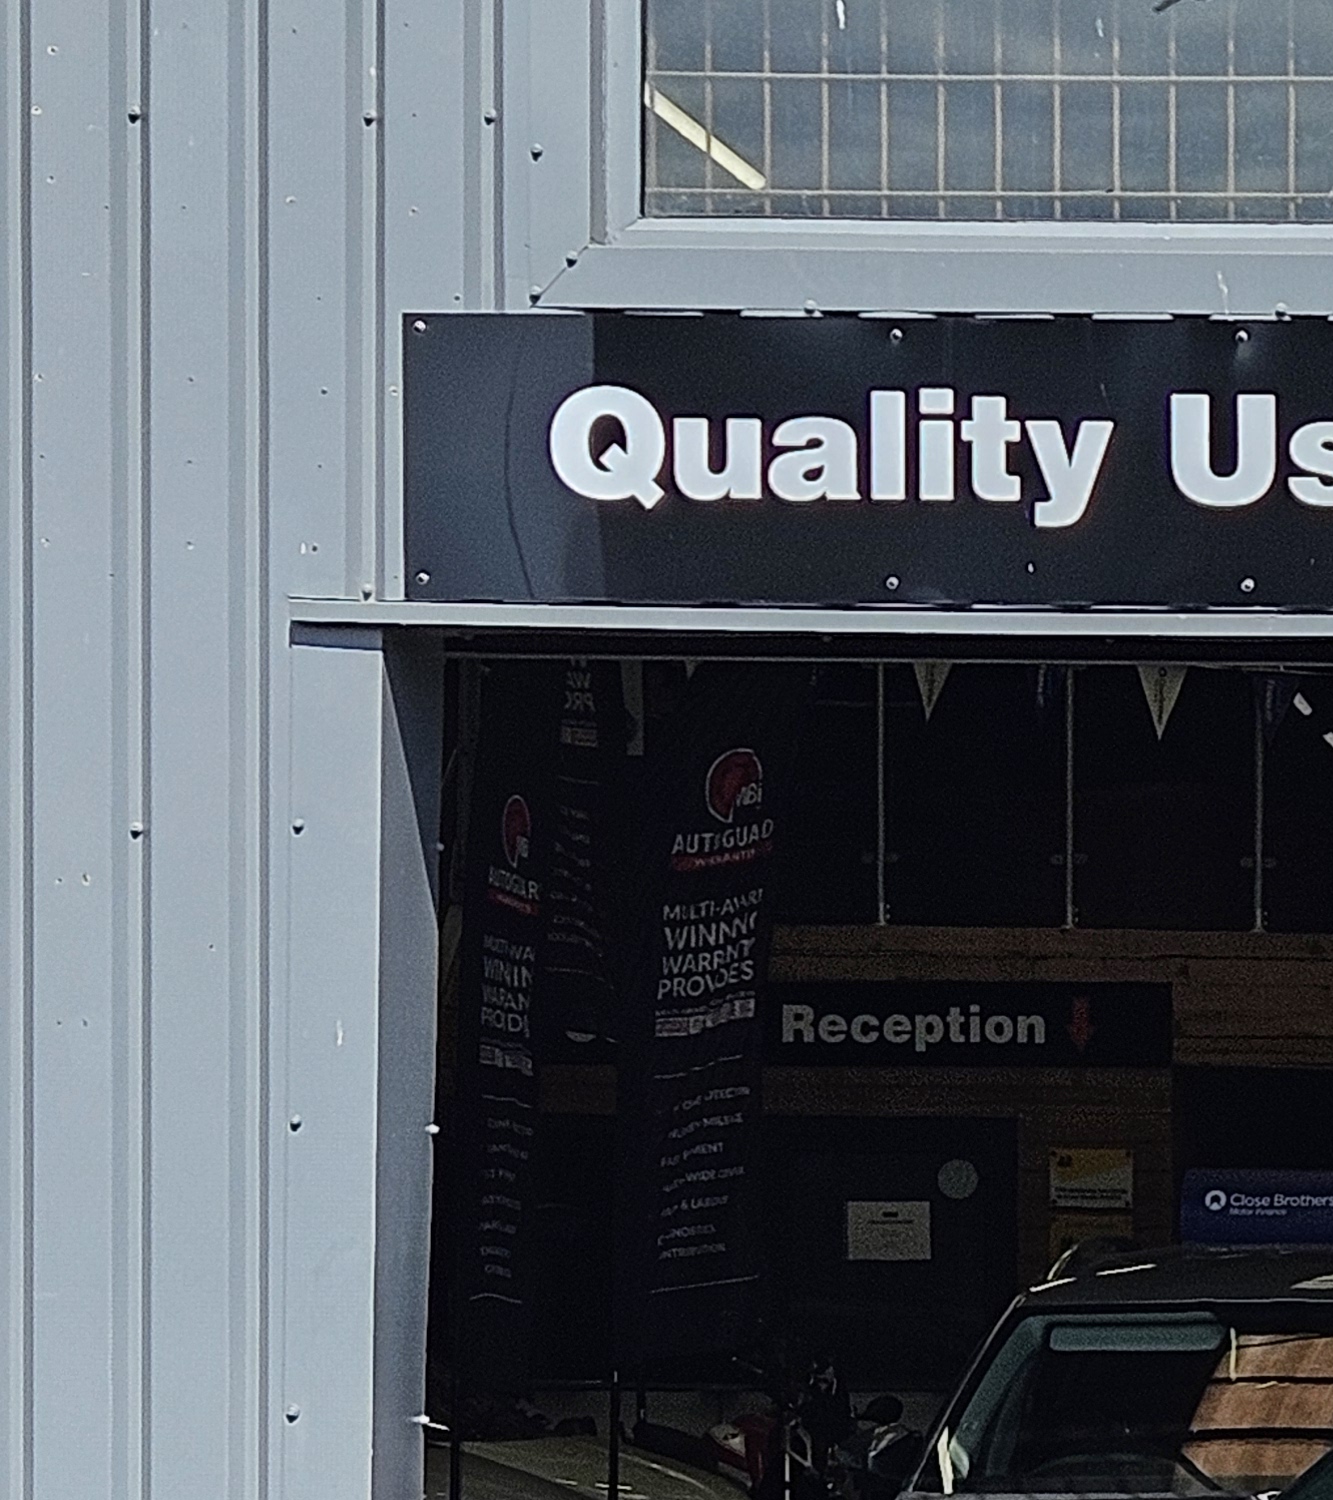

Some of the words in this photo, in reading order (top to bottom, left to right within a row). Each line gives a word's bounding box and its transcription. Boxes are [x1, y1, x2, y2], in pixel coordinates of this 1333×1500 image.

[549, 384, 1114, 528] Quality
[781, 1003, 1046, 1053] Reception
[1229, 1192, 1272, 1208] Close
